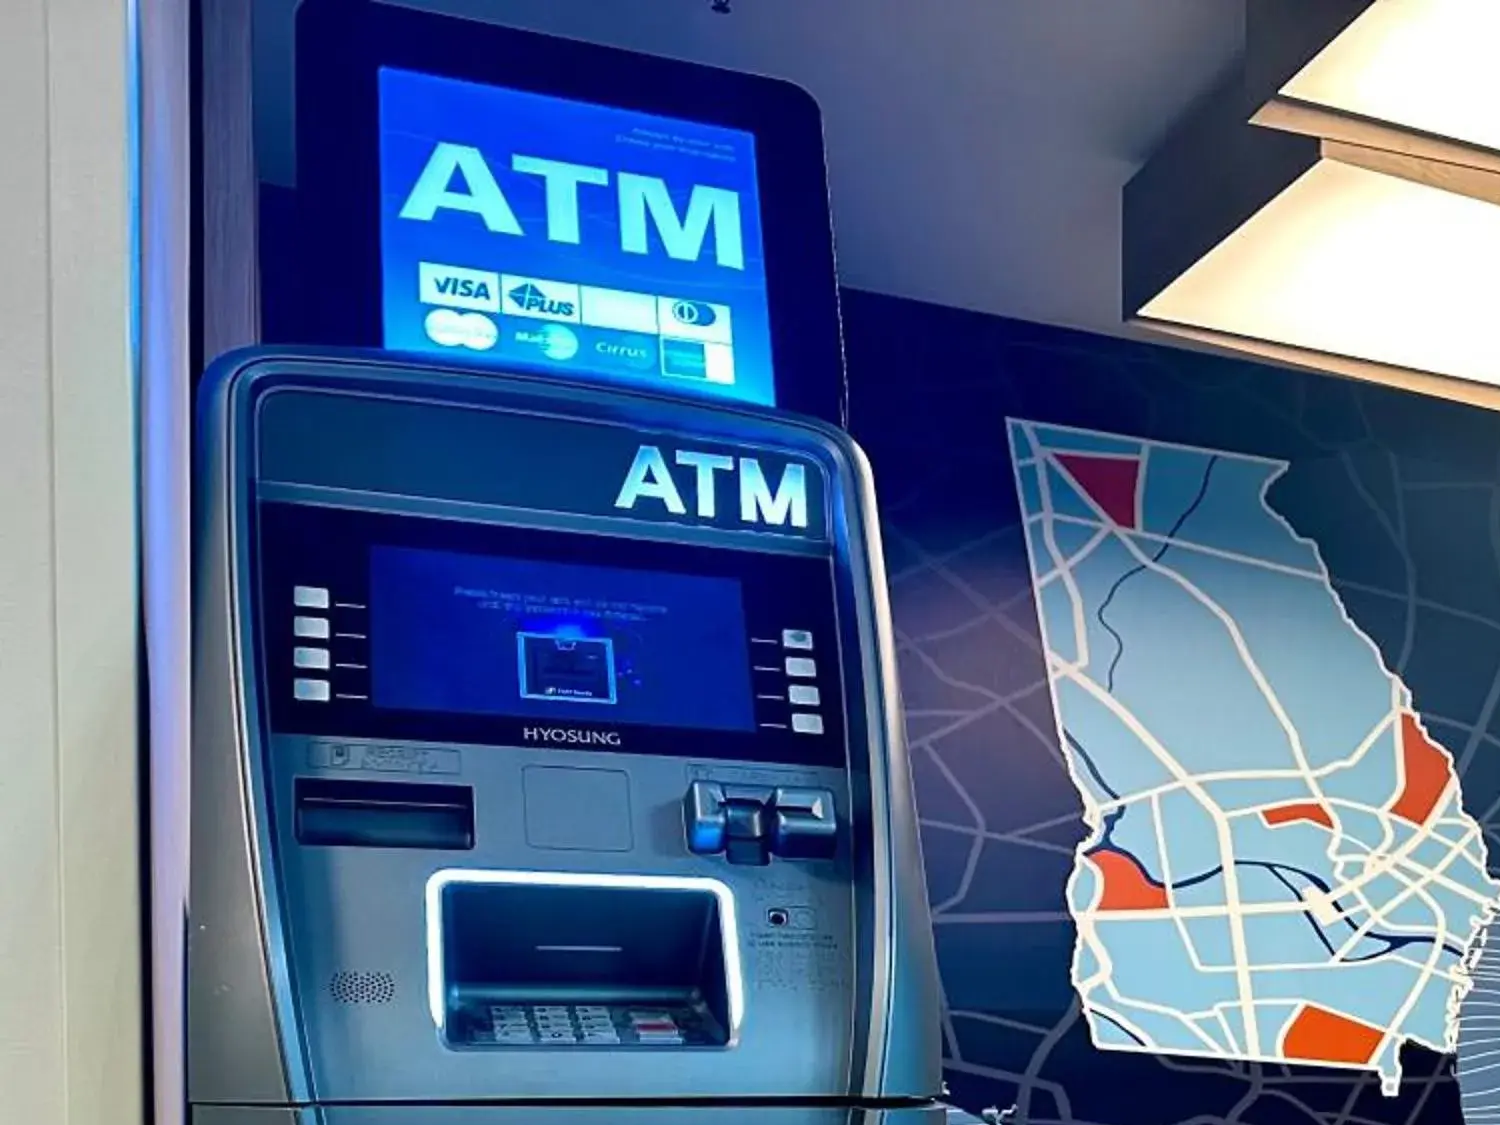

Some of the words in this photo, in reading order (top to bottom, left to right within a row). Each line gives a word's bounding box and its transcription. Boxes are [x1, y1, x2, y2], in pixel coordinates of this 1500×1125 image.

[398, 142, 745, 271] ATM
[434, 277, 491, 300] VISA
[526, 296, 574, 317] PLUS
[595, 341, 648, 359] Cirrus
[614, 444, 809, 529] ATM
[523, 727, 621, 745] HYOSUNG
